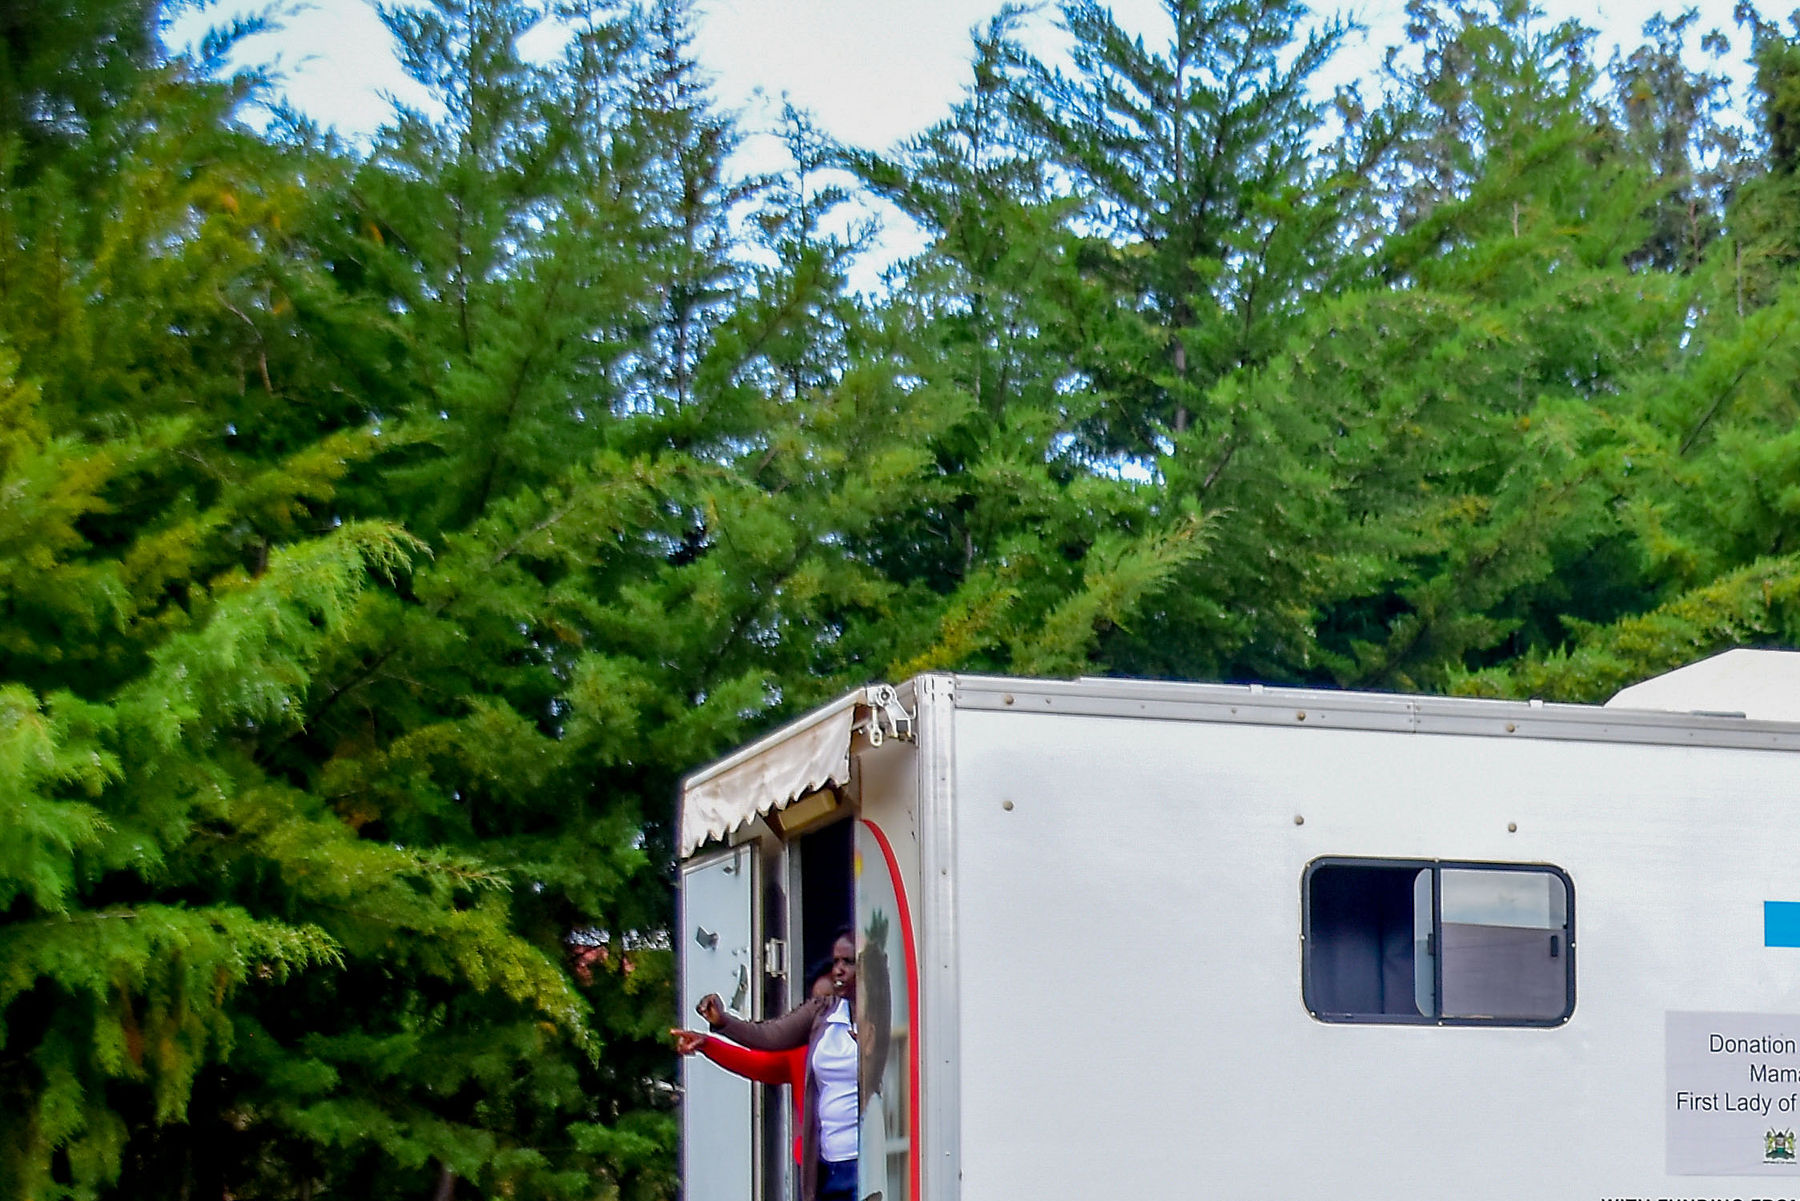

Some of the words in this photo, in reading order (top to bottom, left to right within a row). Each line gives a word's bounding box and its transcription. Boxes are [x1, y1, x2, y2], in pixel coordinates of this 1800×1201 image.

[1710, 1035, 1795, 1053] Donation
[1678, 1092, 1718, 1110] First
[1726, 1093, 1771, 1116] Lady
[1779, 1093, 1797, 1111] of
